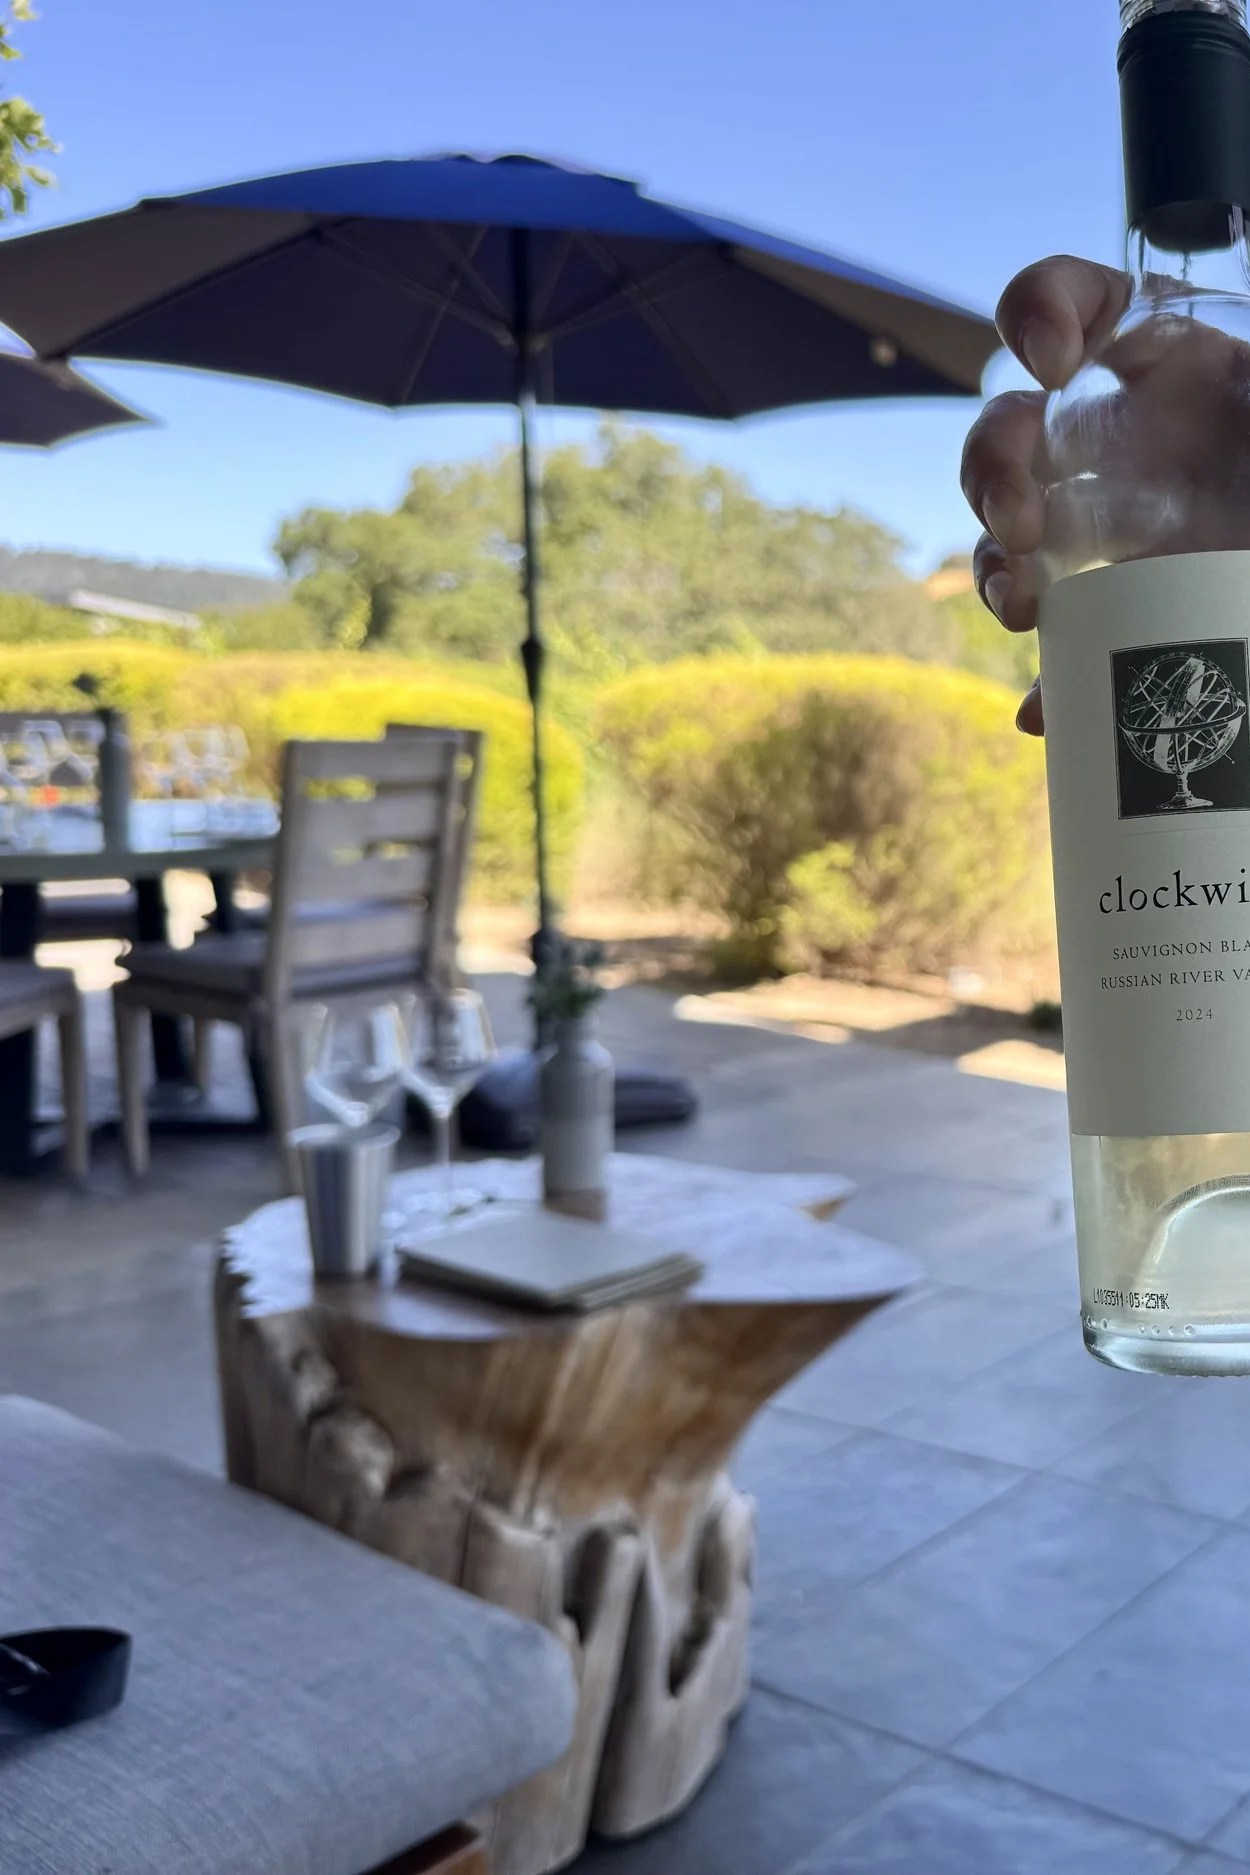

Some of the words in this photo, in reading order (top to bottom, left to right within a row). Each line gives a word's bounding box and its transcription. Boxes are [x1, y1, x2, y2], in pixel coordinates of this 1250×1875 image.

[1112, 941, 1213, 961] SAUVIGNON
[1100, 972, 1163, 990] RUSSIAN
[1169, 969, 1226, 986] RIVER
[1175, 1007, 1214, 1022] 2024
